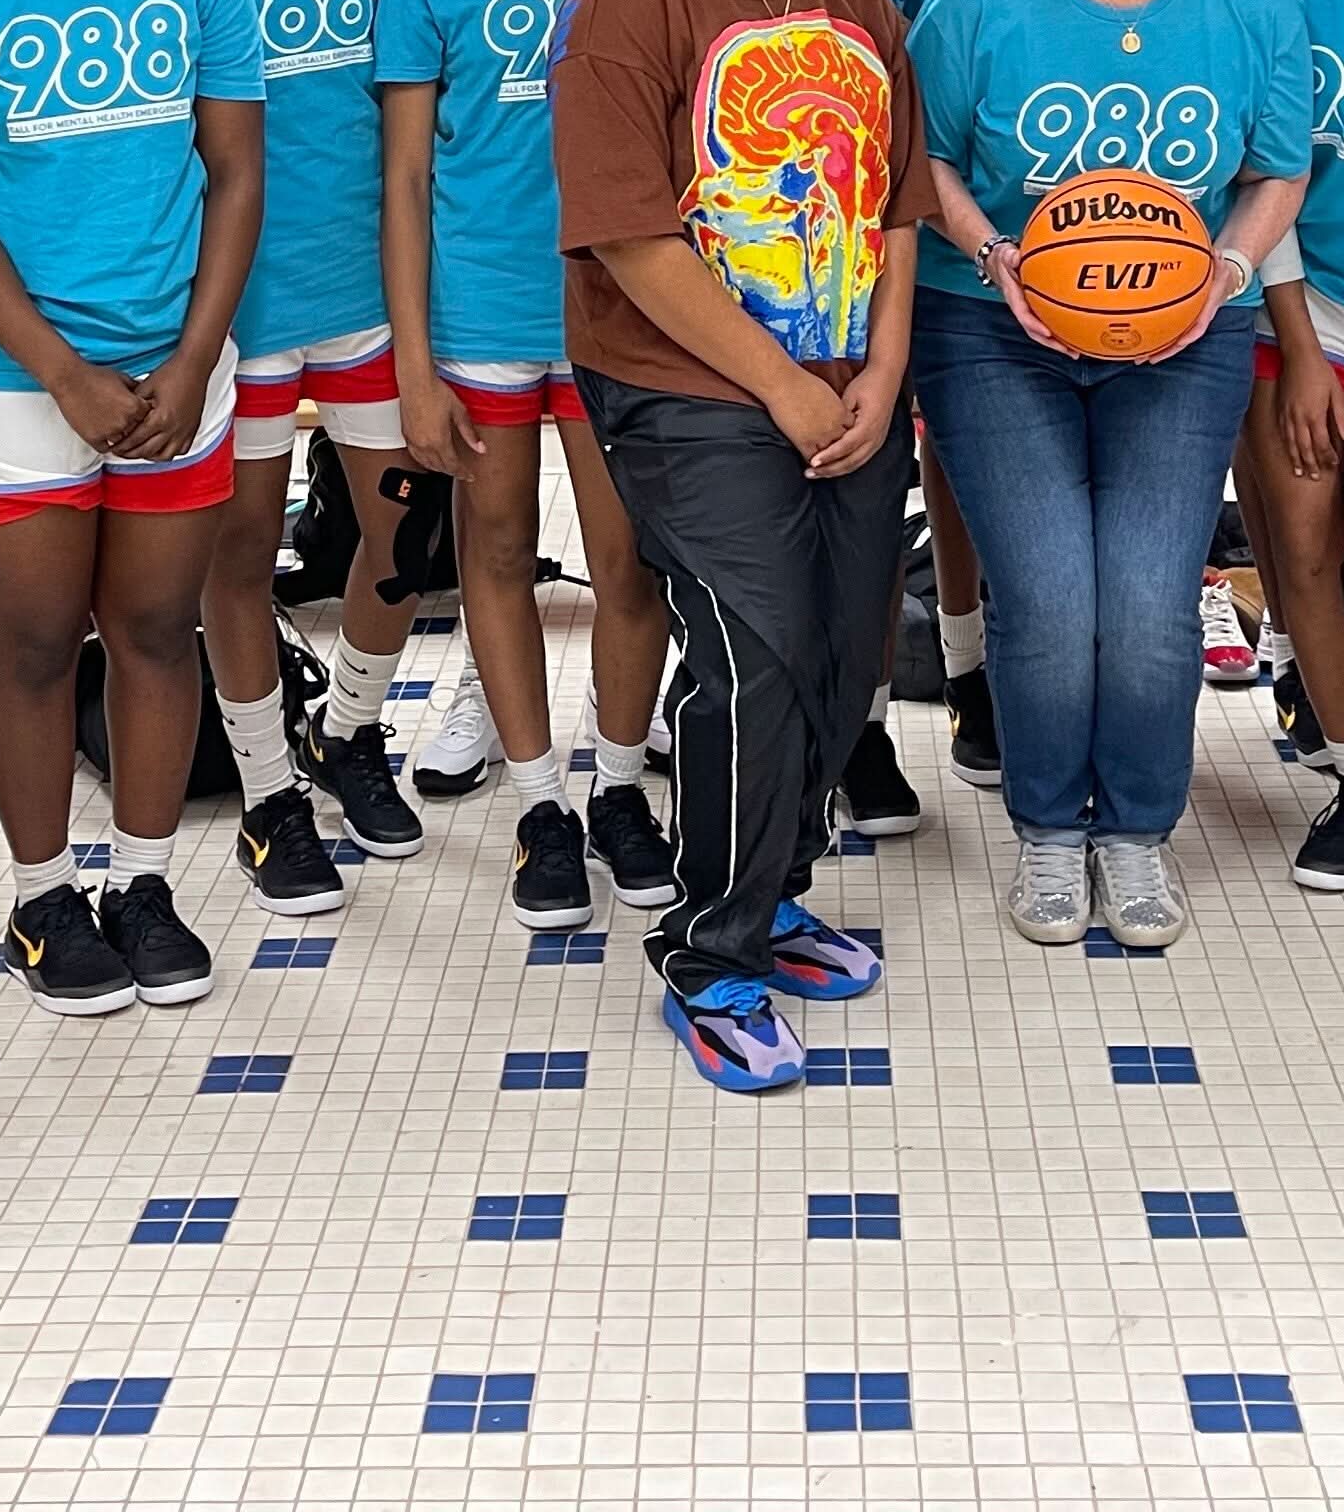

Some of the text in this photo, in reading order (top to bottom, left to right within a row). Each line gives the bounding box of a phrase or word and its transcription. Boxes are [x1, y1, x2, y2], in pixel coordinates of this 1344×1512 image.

[33, 122, 54, 132] FOR
[56, 117, 94, 128] MENTAL
[96, 110, 134, 122] HEALTH
[1016, 82, 1220, 186] 988
[1049, 192, 1183, 232] Wilson
[1077, 262, 1158, 290] EVO
